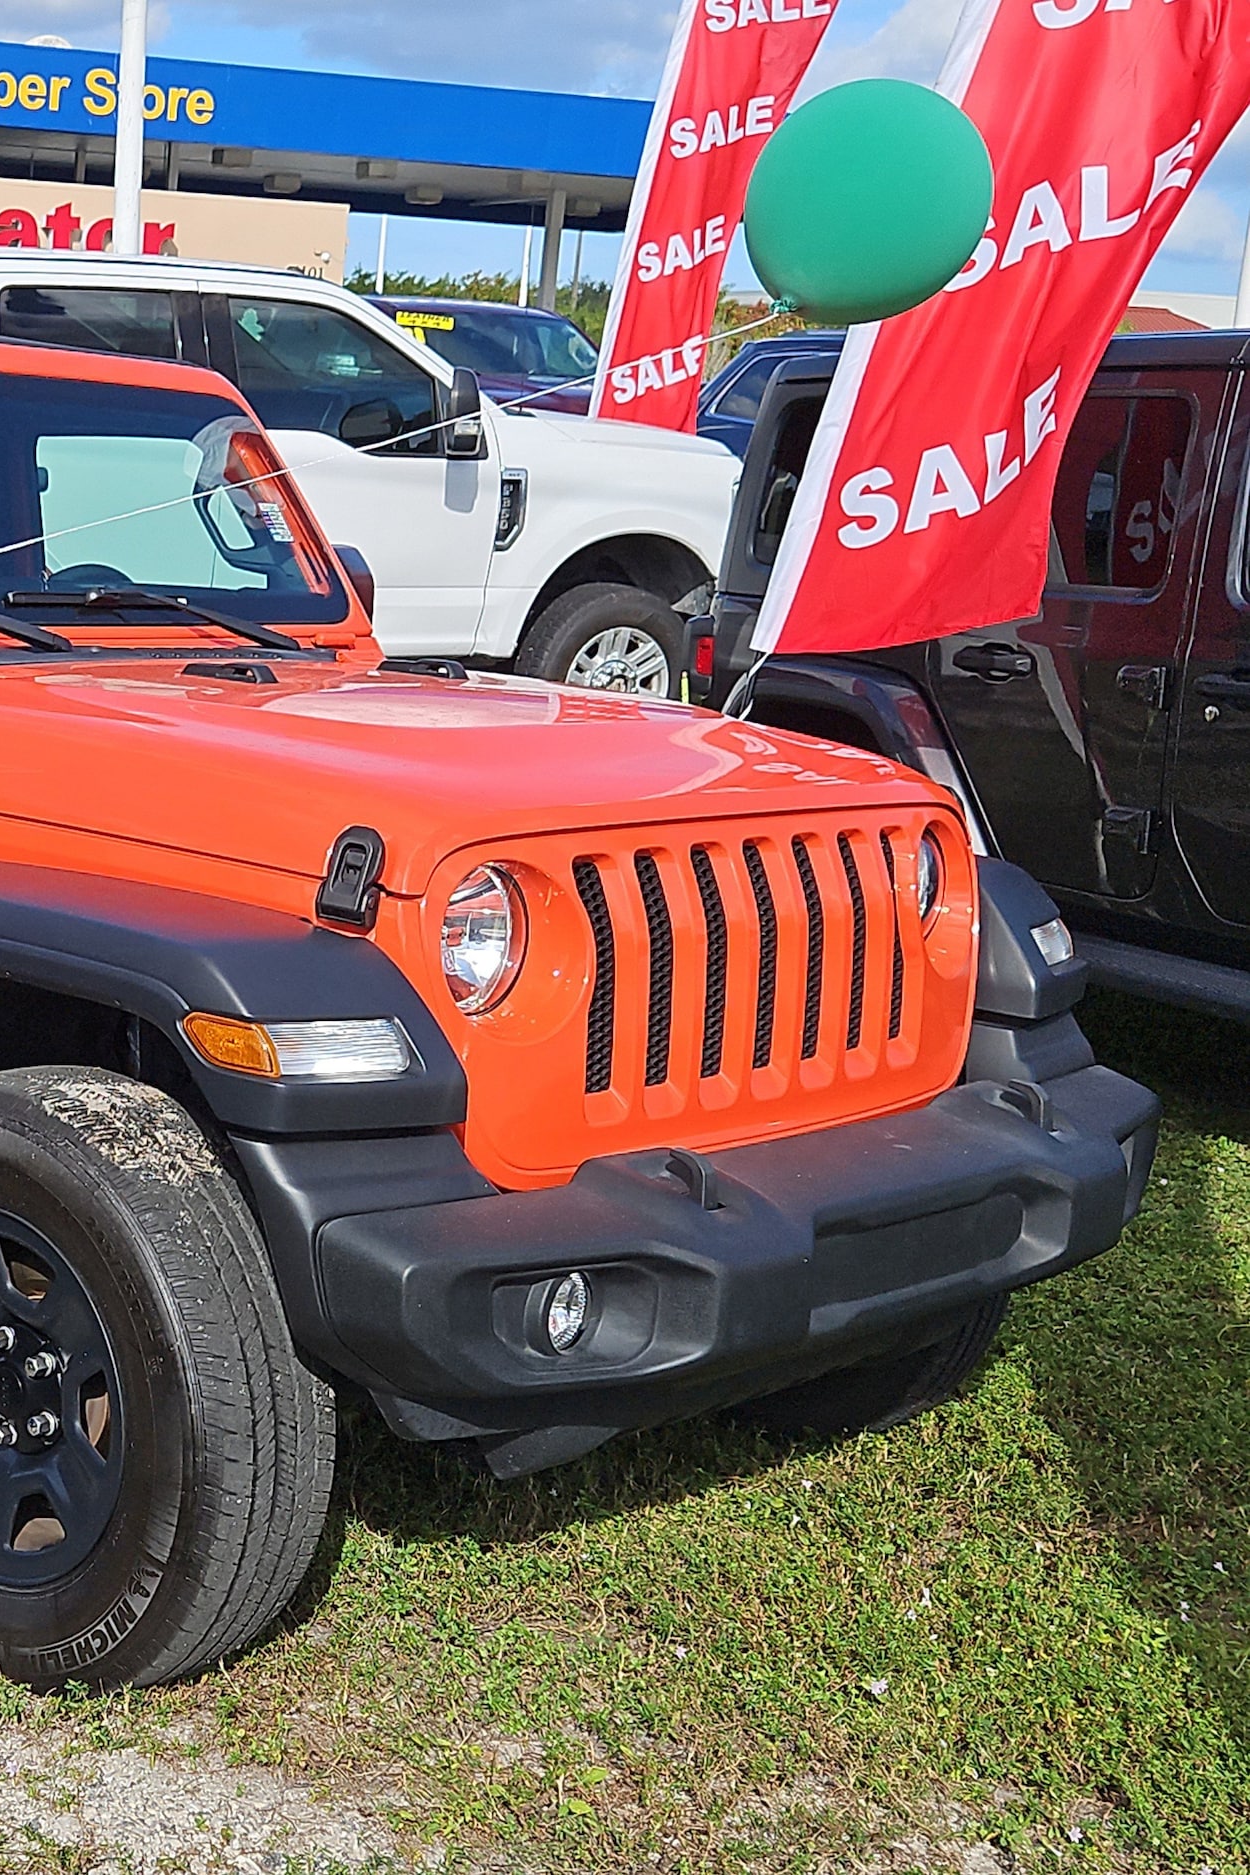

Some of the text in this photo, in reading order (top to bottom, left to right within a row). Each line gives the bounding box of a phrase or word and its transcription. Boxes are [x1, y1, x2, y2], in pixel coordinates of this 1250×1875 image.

[83, 68, 216, 124] Sore
[670, 95, 775, 159] SALE
[637, 213, 727, 283] SALE
[610, 333, 704, 405] SALE
[837, 365, 1062, 549] SALE
